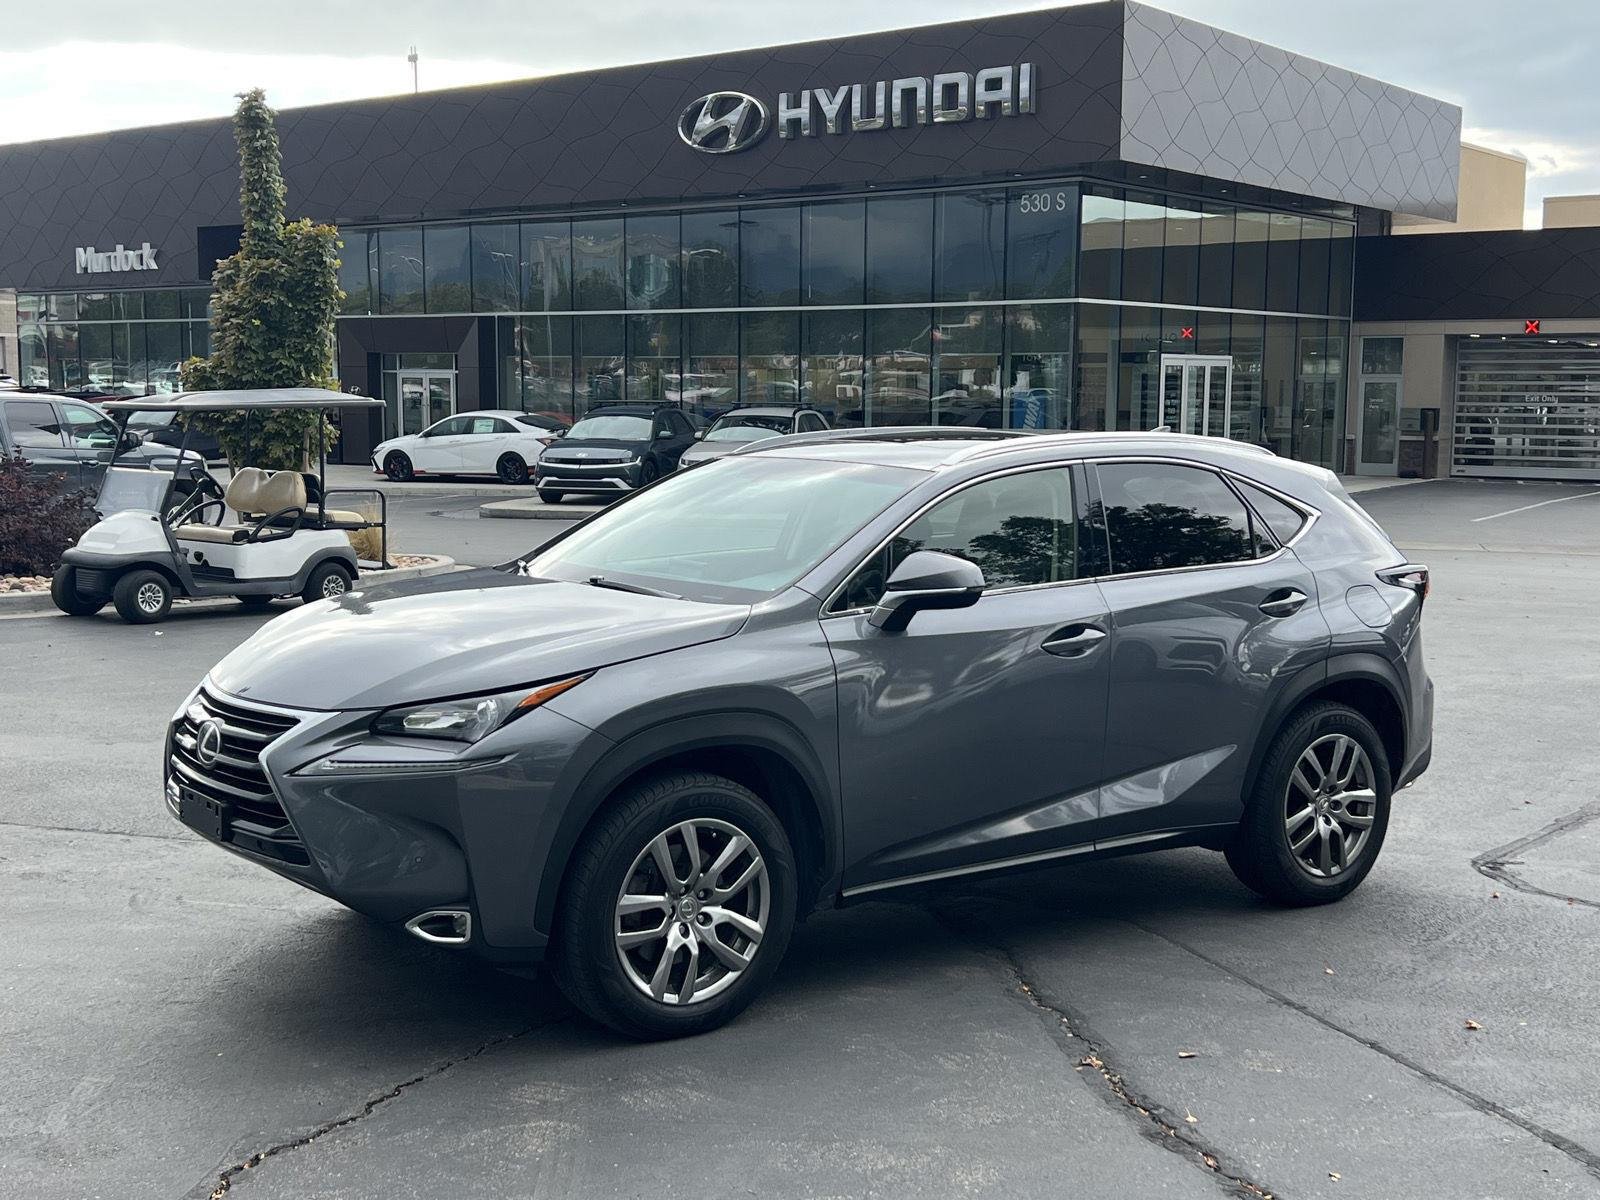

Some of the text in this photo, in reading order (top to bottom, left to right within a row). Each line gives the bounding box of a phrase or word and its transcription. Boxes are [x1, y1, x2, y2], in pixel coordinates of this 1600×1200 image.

[778, 62, 1036, 139] HYUNDAI
[1020, 192, 1066, 213] 530 S
[75, 242, 159, 274] Murdock
[1525, 394, 1540, 402] Exit
